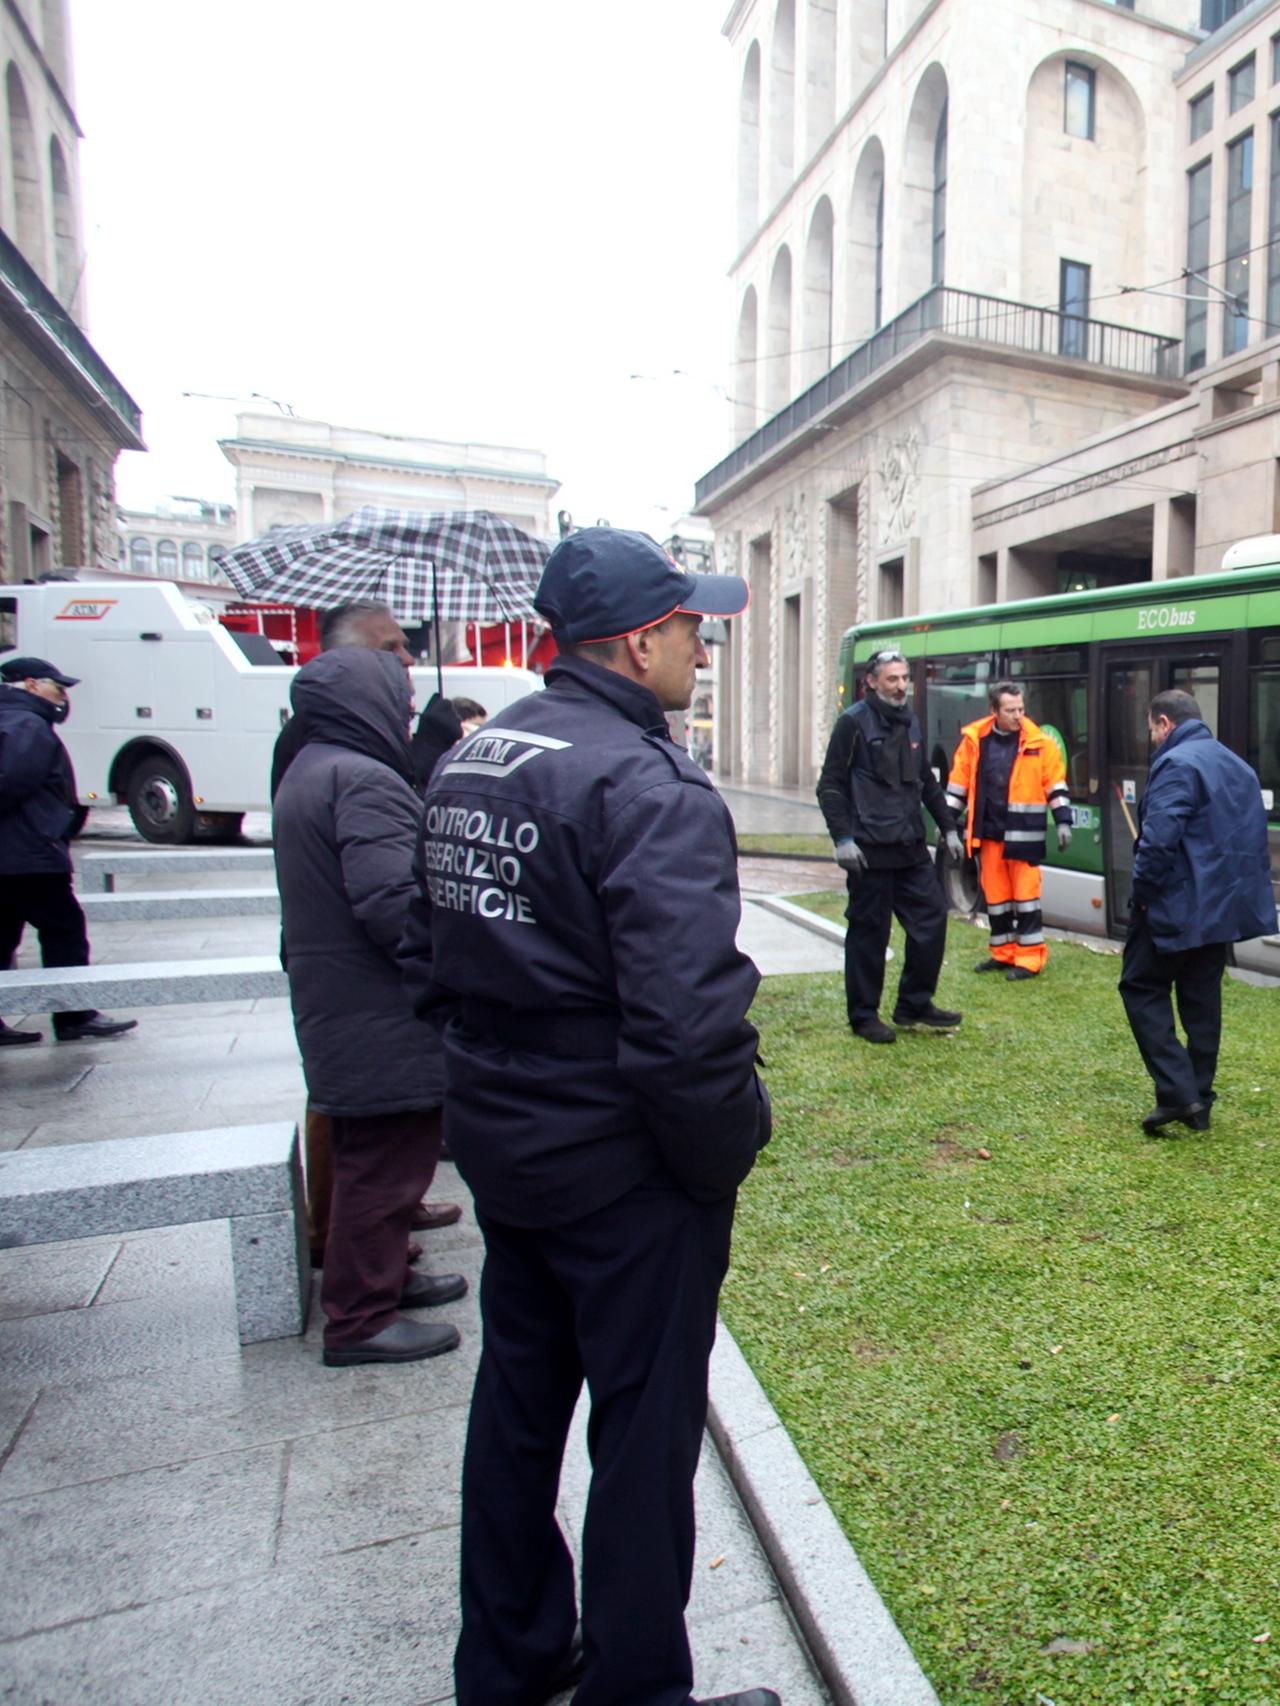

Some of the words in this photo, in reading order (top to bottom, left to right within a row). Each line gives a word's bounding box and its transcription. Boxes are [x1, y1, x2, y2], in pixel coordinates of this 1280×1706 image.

[73, 604, 98, 616] ATM
[1137, 607, 1196, 630] ECObus
[465, 738, 516, 764] ATM
